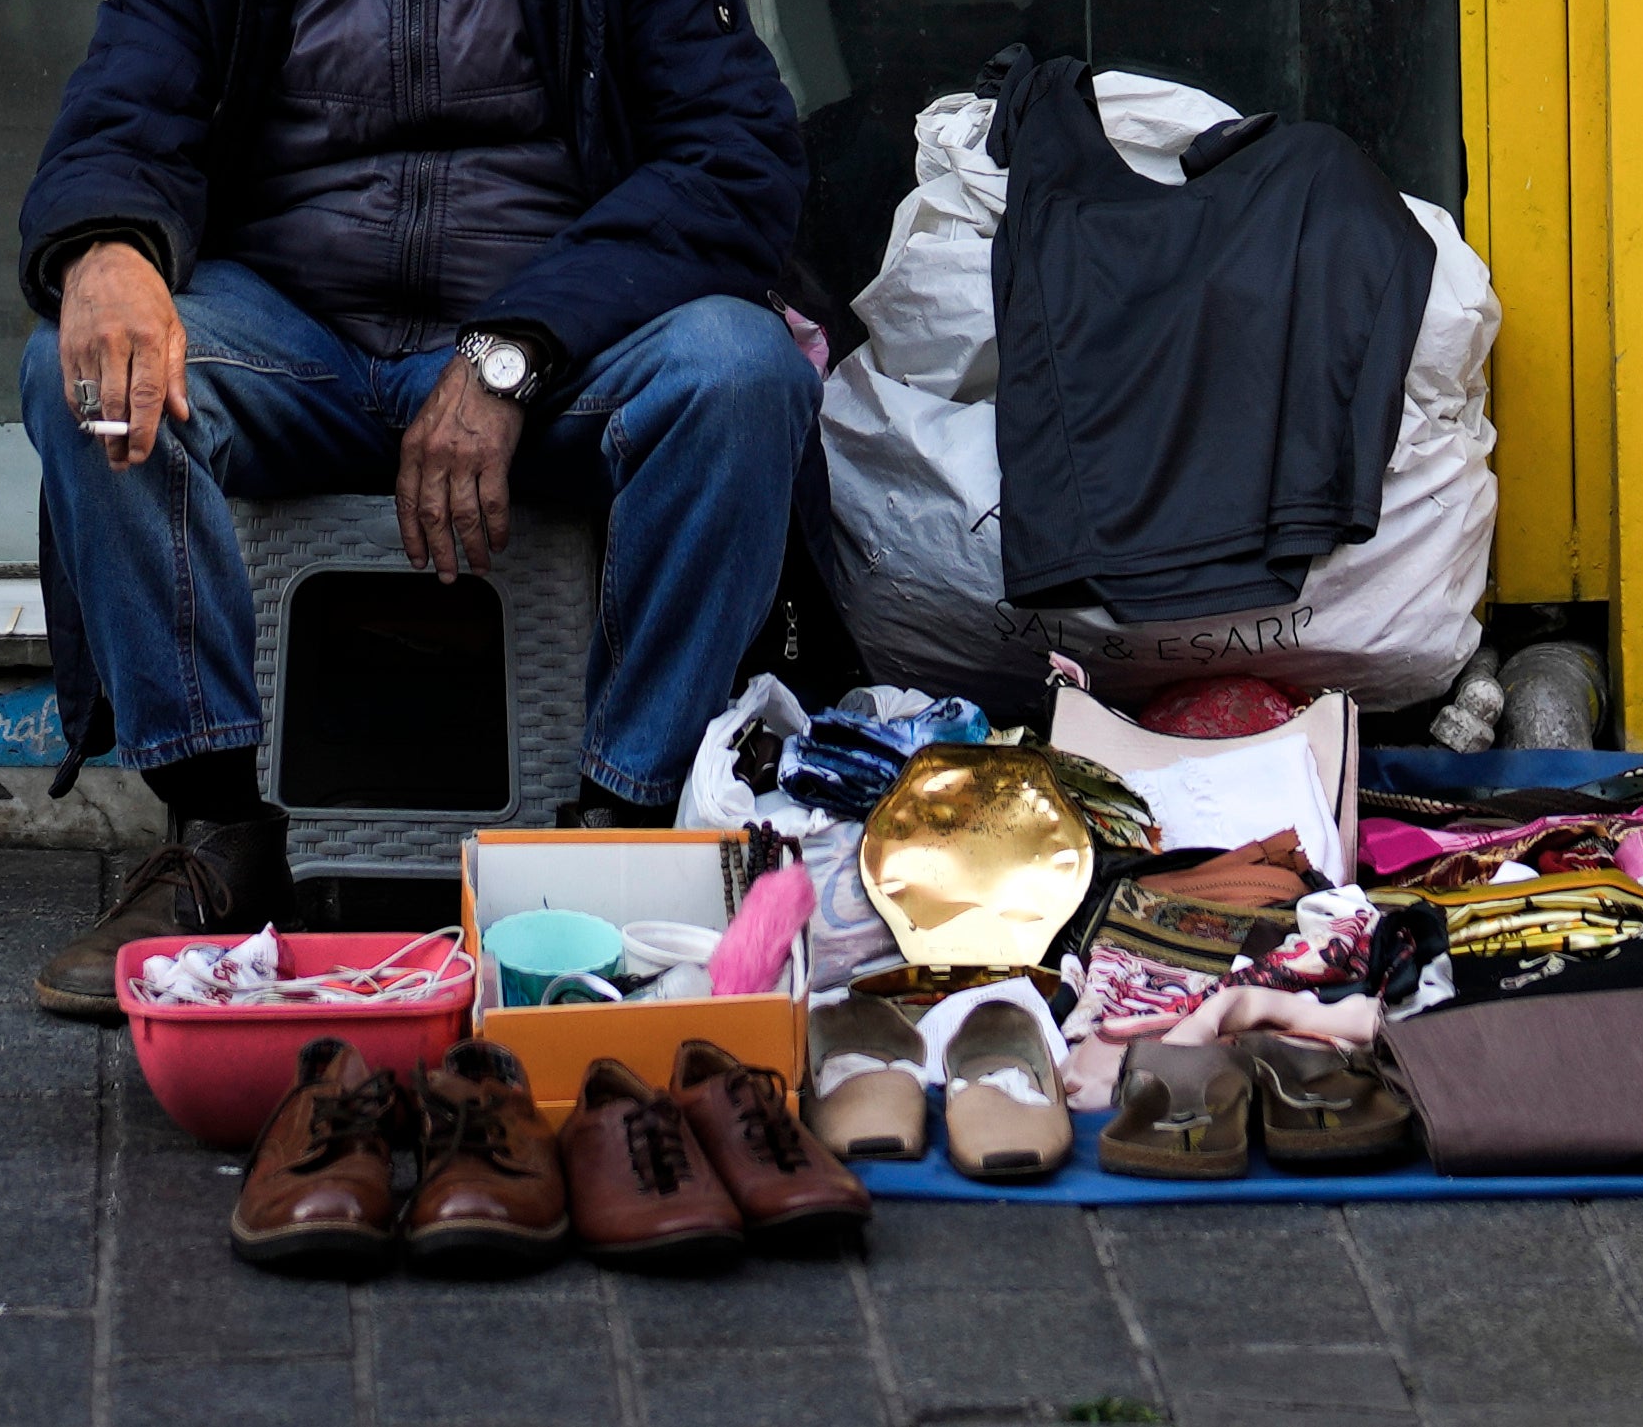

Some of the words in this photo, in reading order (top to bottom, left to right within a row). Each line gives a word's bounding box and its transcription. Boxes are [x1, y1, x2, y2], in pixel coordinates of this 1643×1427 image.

[993, 599, 1080, 653] ŞAL
[1103, 635, 1134, 660] &
[1158, 606, 1313, 665] EŞARP
